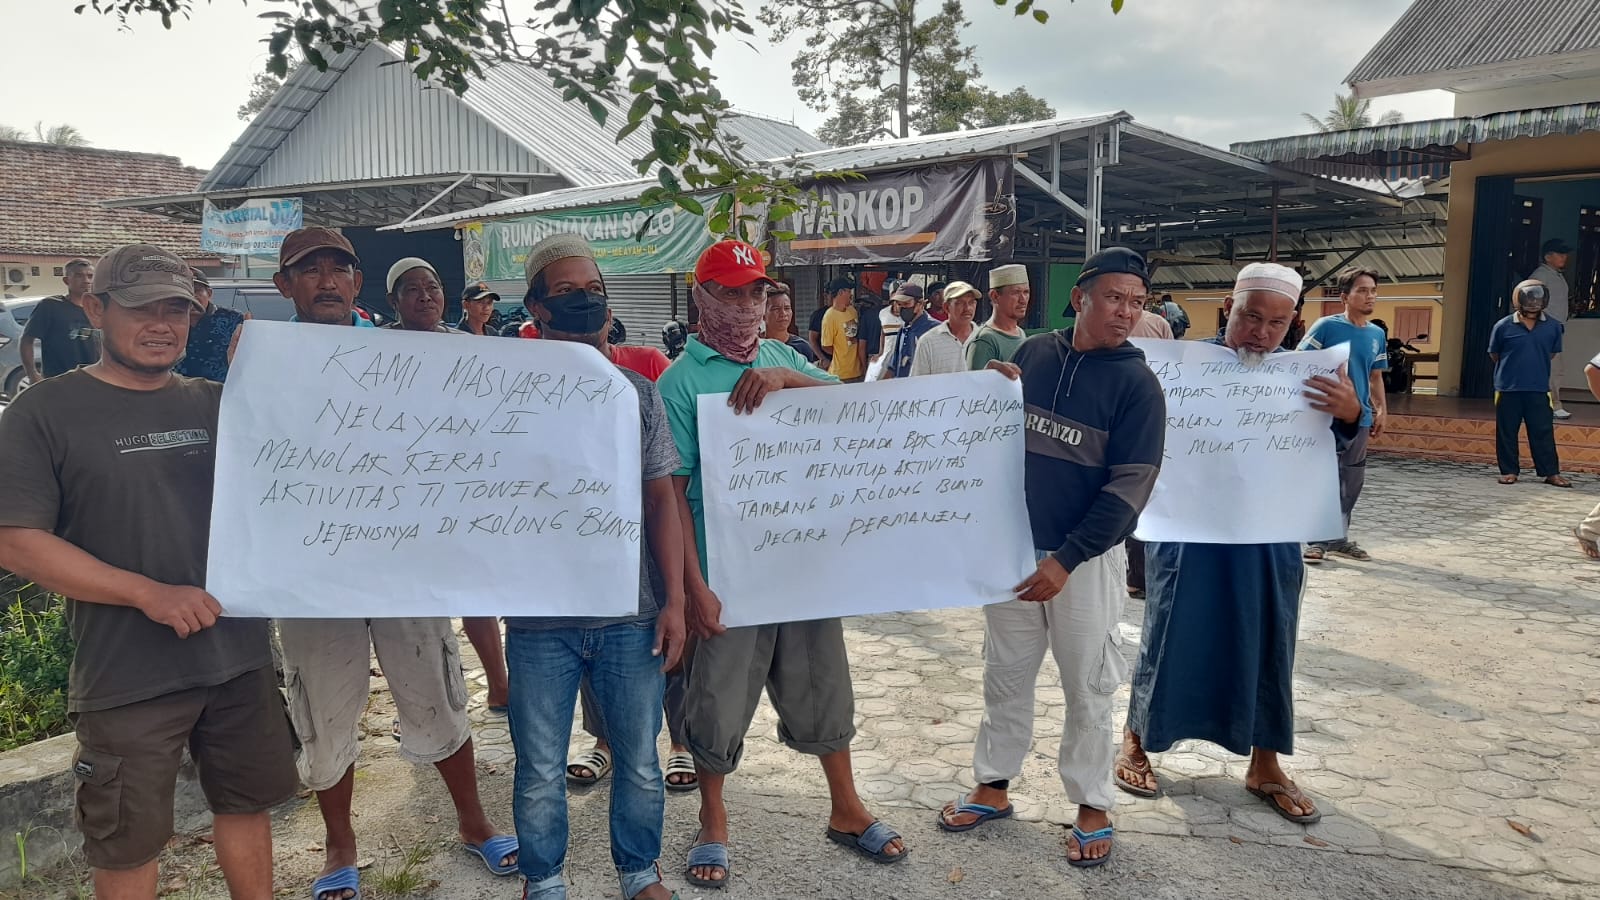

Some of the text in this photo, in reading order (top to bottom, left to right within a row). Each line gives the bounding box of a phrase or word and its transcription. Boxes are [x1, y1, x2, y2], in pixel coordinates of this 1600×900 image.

[623, 208, 675, 239] SOLO
[792, 186, 924, 235] WARKOP
[315, 399, 540, 451] NELAYAN II
[770, 393, 1023, 434] KAMI MASYARAKAT NELAYAN
[1236, 408, 1303, 432] TEMPAT
[115, 429, 208, 447] HUGO SELECTION
[729, 437, 751, 468] II
[754, 438, 821, 462] MEMINTA
[832, 436, 893, 459] KEPADA
[1188, 438, 1259, 456] MUAT
[253, 438, 501, 476] MENOLAK KERAS
[728, 470, 788, 491] UNTUK
[805, 462, 887, 484] MENUTUP
[260, 479, 406, 511] AKTIVITAS
[418, 482, 445, 507] TI
[455, 480, 558, 503] TOWER
[737, 497, 817, 521] TAMBANG
[851, 481, 923, 504] KOLONG
[468, 505, 569, 536] KOLONG
[576, 507, 641, 543] BUNTU
